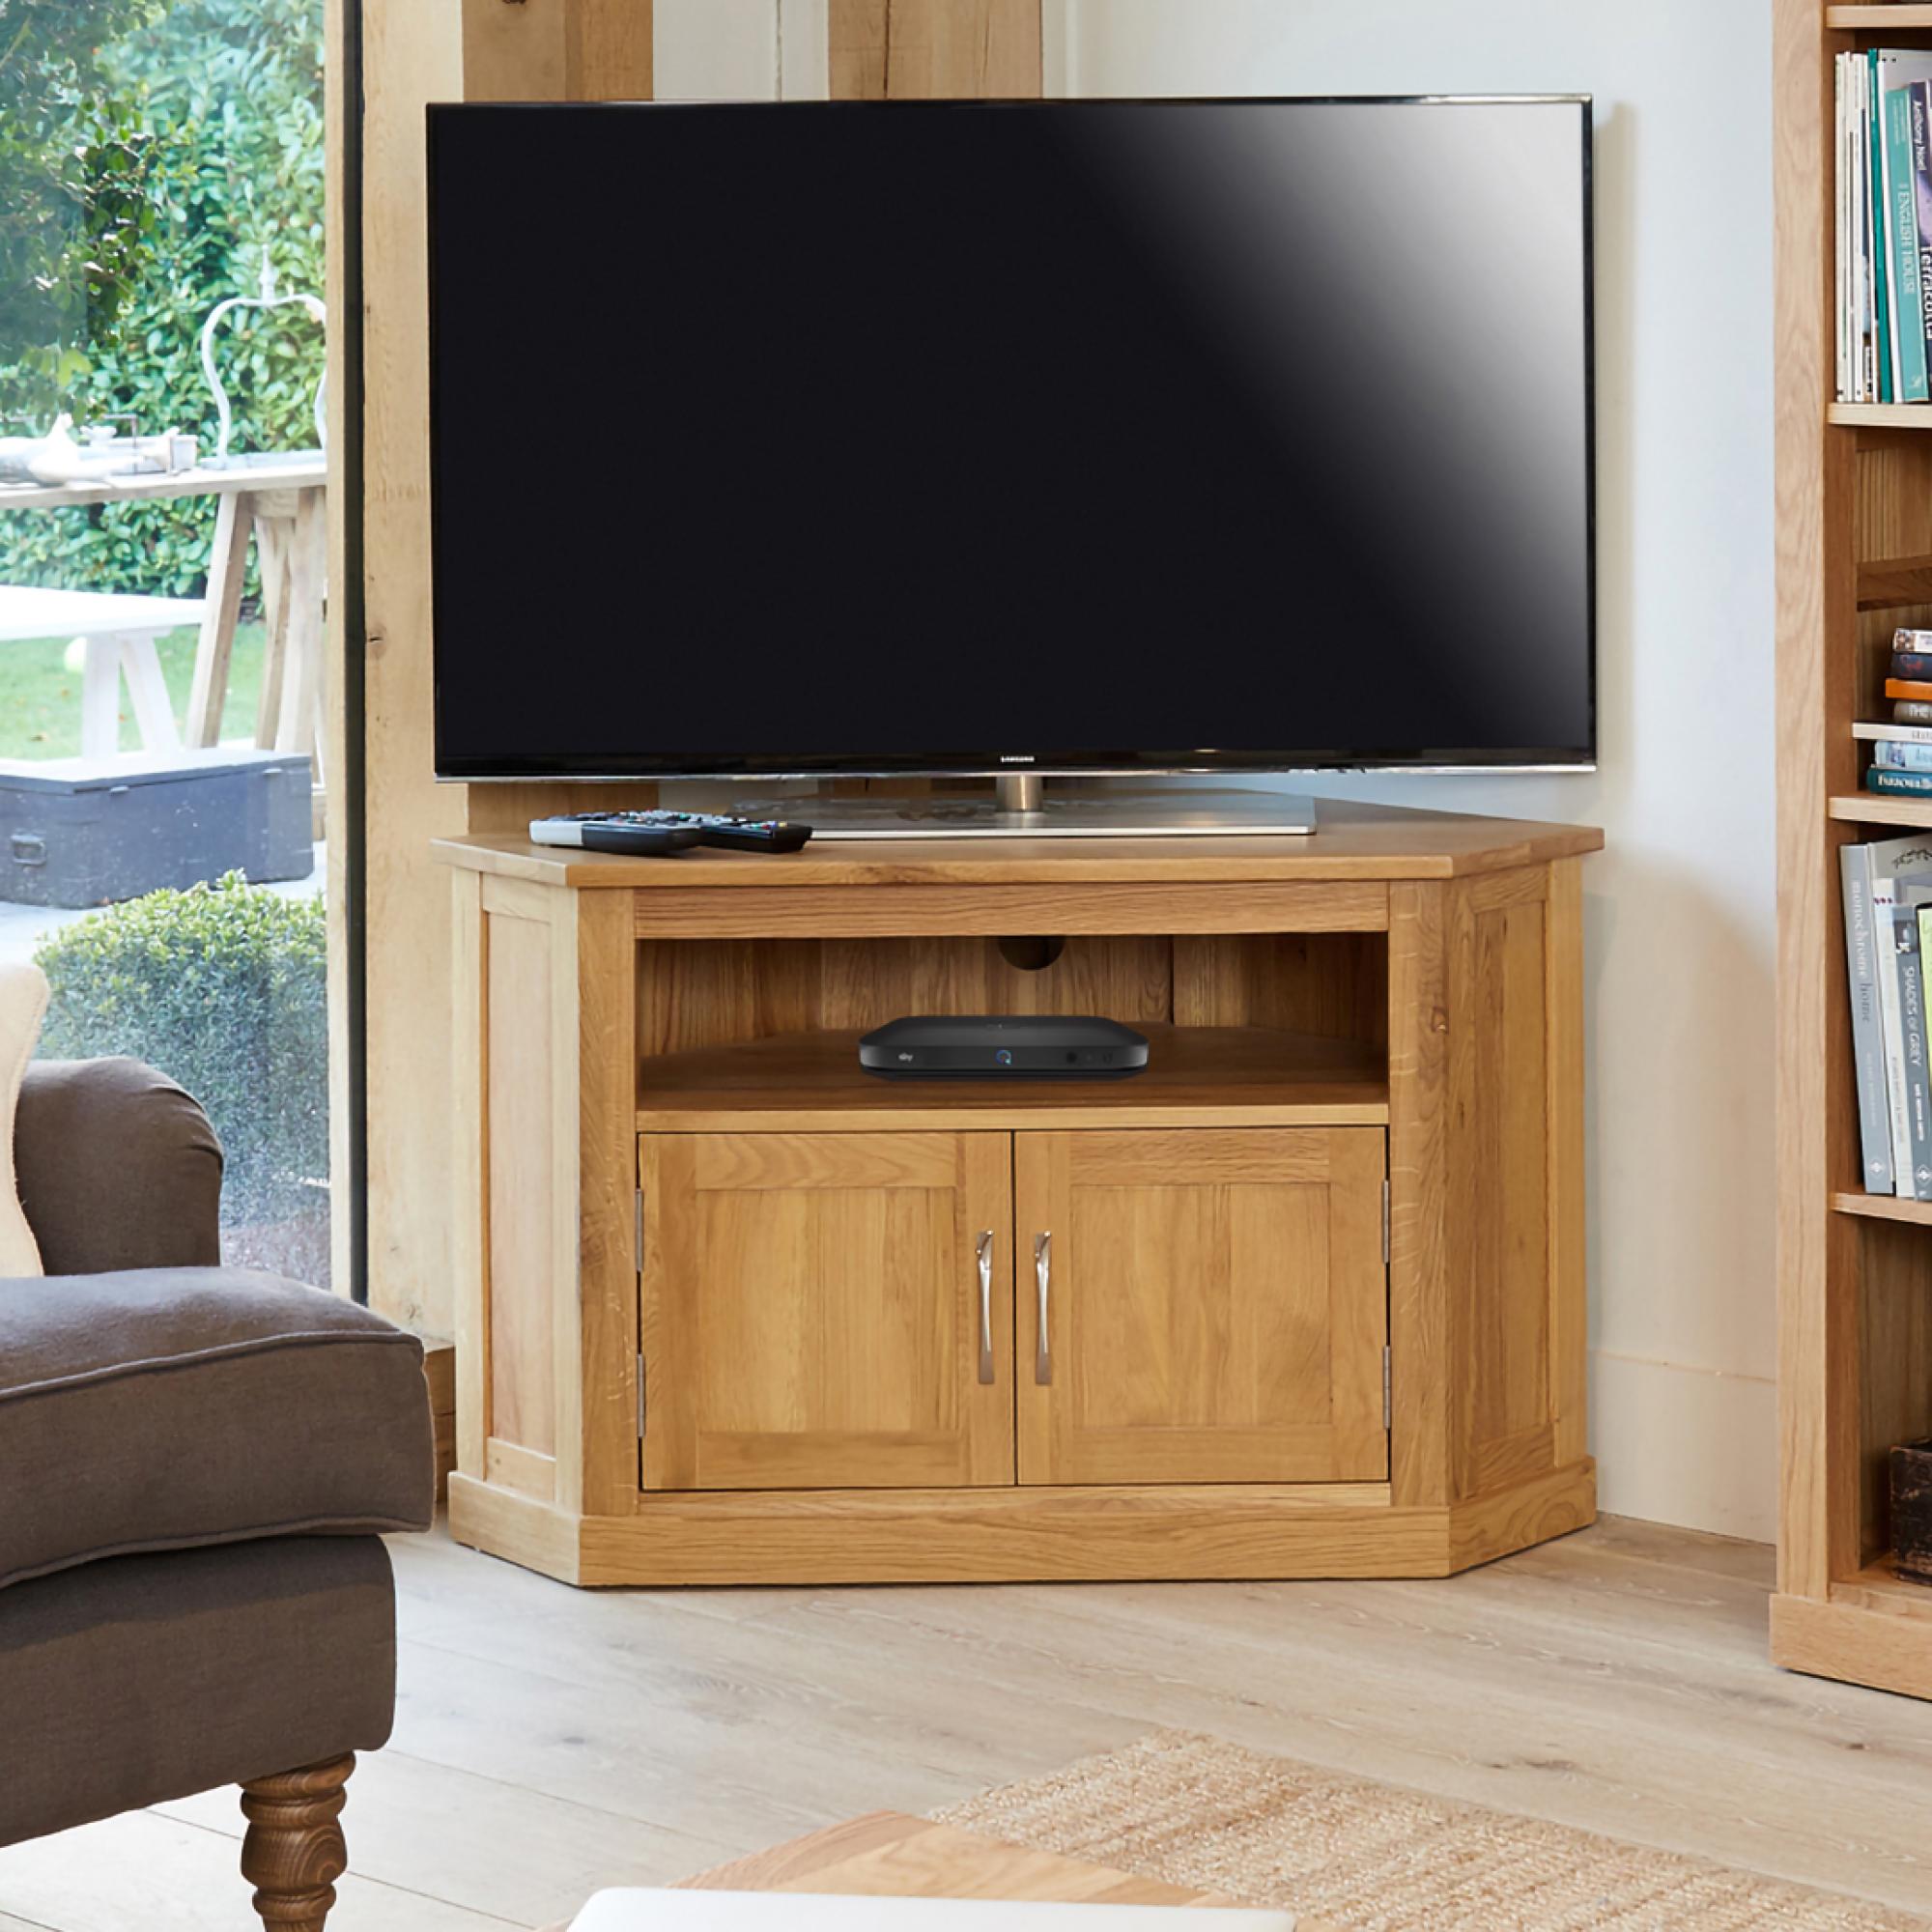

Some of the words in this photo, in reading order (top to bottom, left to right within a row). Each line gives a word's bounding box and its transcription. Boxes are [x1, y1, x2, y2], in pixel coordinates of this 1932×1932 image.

[1914, 100, 1924, 144] Anthony
[1916, 146, 1927, 171] Noel
[1898, 191, 1914, 246] ENGLISH
[1902, 250, 1917, 294] HOUSE
[1852, 881, 1868, 978] monochrome
[1860, 982, 1873, 1023] home
[1902, 966, 1918, 1014] SHADES
[1909, 1034, 1921, 1066] GREY
